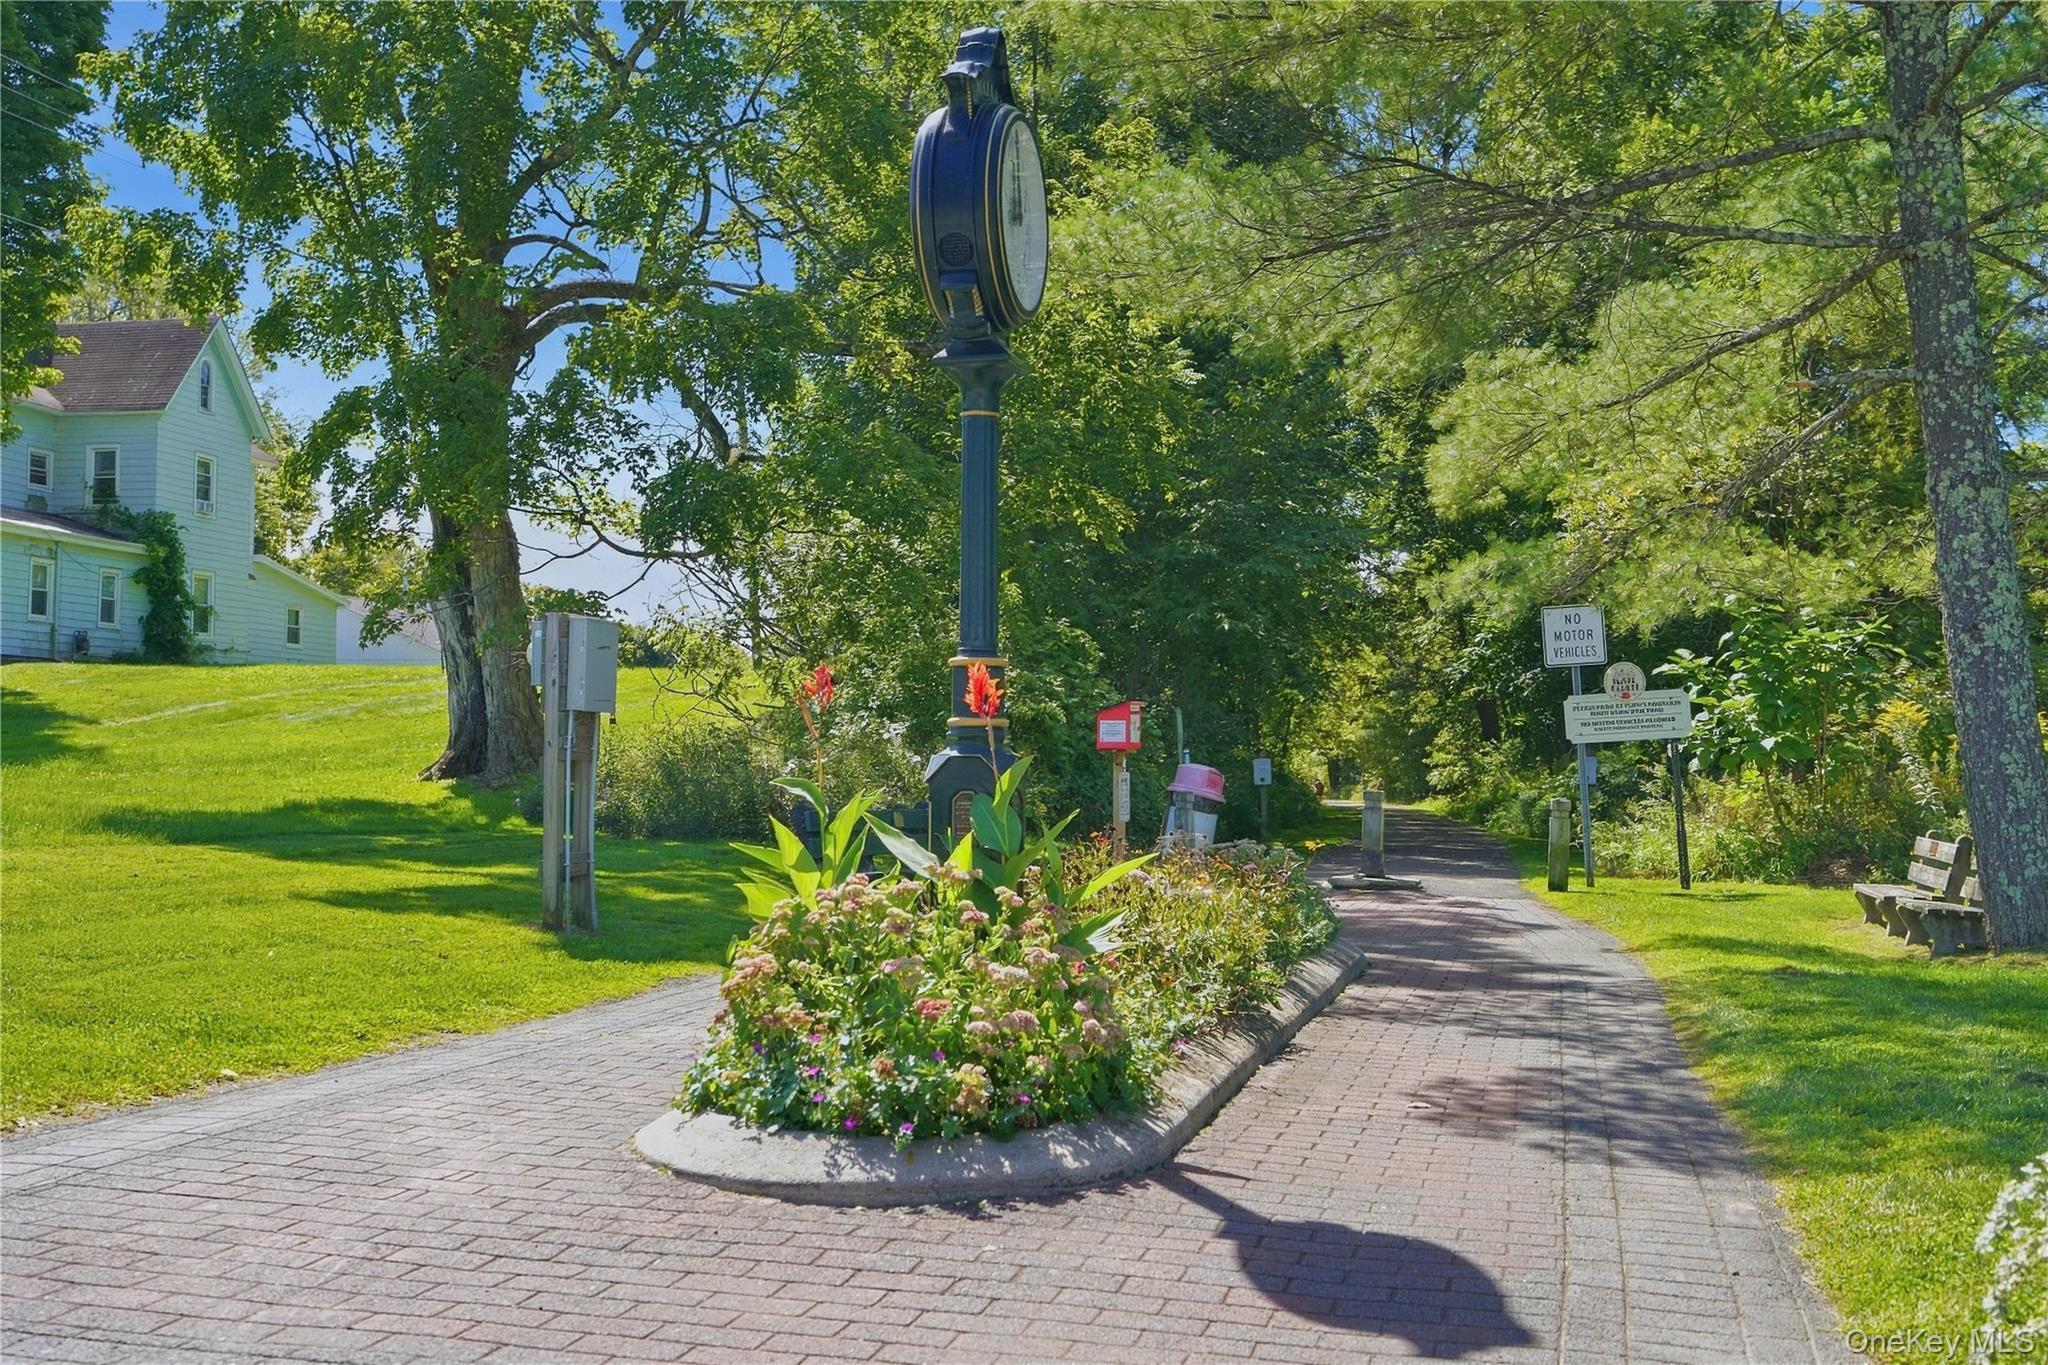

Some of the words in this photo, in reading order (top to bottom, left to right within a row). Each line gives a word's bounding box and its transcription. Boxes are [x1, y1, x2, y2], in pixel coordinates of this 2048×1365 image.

[1564, 613, 1581, 625] NO
[1554, 629, 1594, 642] MOTOR
[1553, 645, 1597, 659] VEHICLES
